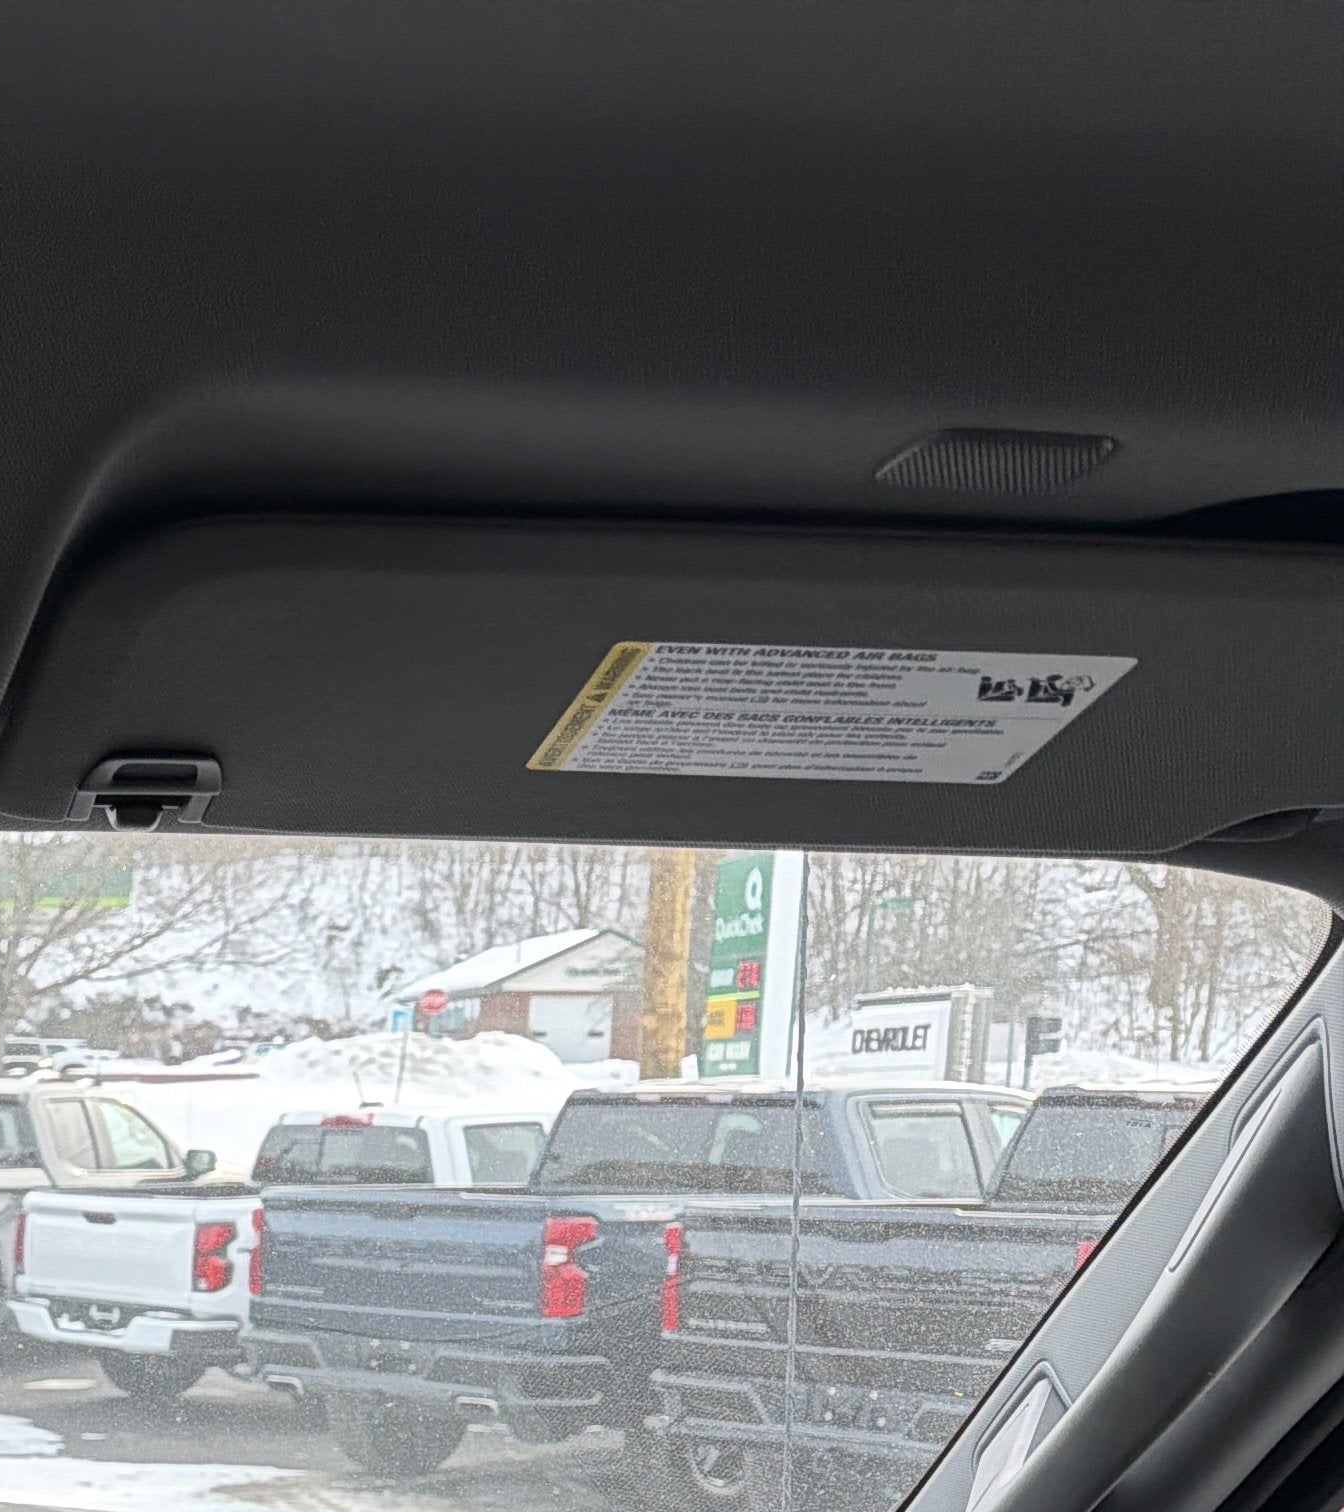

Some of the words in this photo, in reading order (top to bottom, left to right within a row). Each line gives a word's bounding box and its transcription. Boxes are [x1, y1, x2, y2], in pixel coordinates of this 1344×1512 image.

[656, 645, 700, 655] EVEN
[705, 646, 750, 656] WITH
[753, 647, 850, 659] ADVANCED
[853, 652, 885, 660] AIR
[888, 653, 937, 662] BAGS
[658, 710, 700, 719] AVEC
[703, 712, 735, 720] DES
